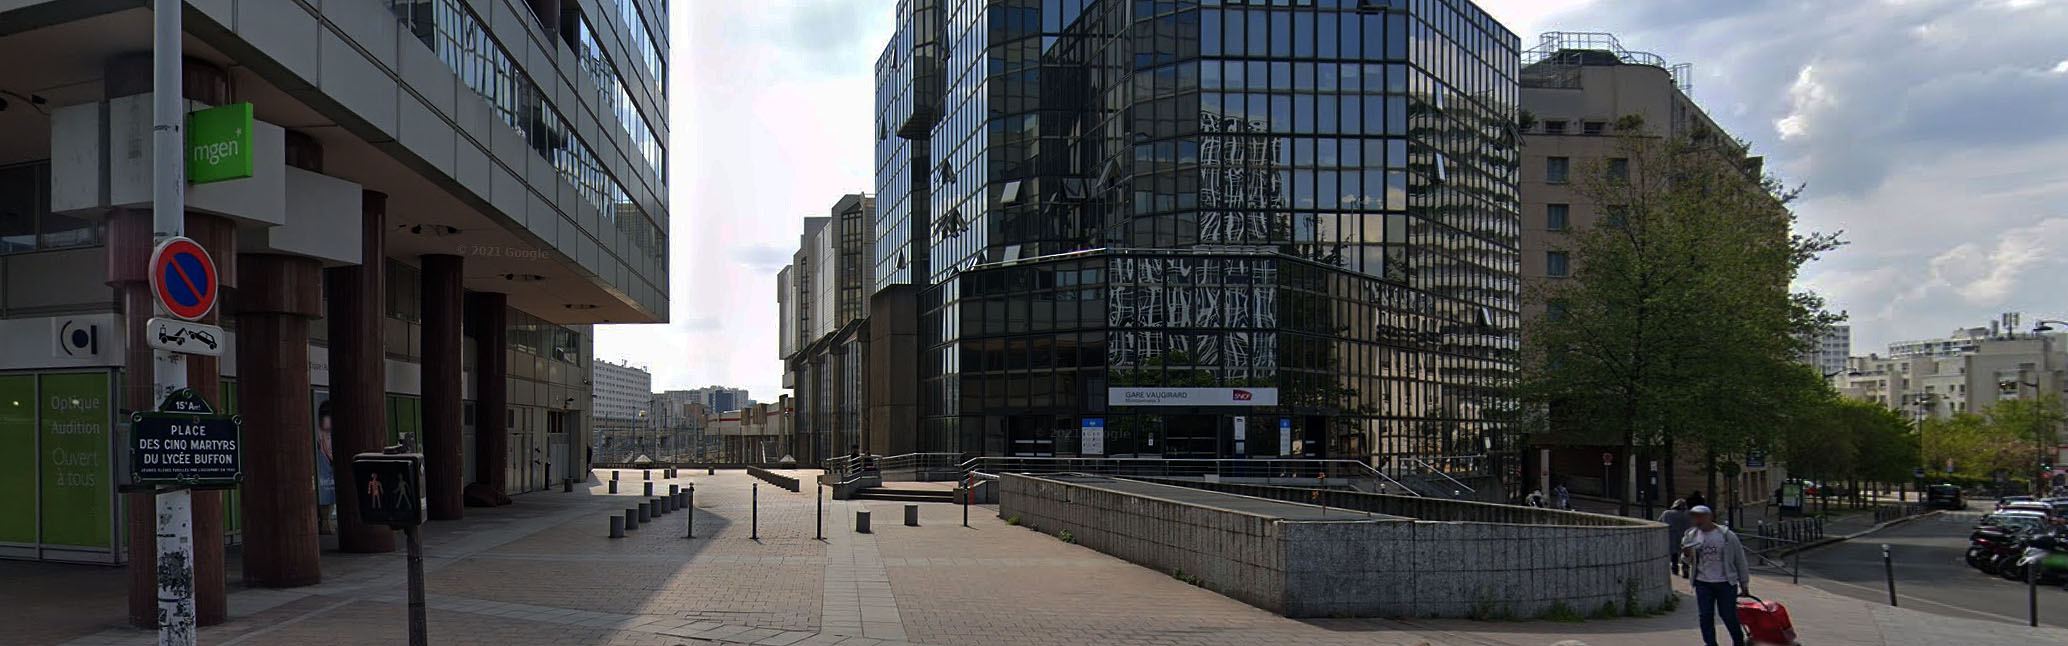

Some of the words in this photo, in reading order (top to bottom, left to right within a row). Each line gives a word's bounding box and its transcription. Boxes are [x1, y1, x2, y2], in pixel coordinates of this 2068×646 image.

[1125, 391, 1144, 399] GARE
[1145, 391, 1188, 399] VAUGIRARD
[51, 396, 100, 412] Optique
[51, 420, 100, 434] Audition
[171, 425, 206, 436] PLACE
[139, 439, 160, 450] DES
[164, 439, 187, 451] CINQ
[190, 439, 236, 451] MARTYRS
[52, 447, 98, 467] Ouvert
[144, 453, 159, 464] DU
[162, 451, 191, 464] LYCÉE
[194, 453, 233, 464] BUFFON
[68, 472, 95, 487] tous
